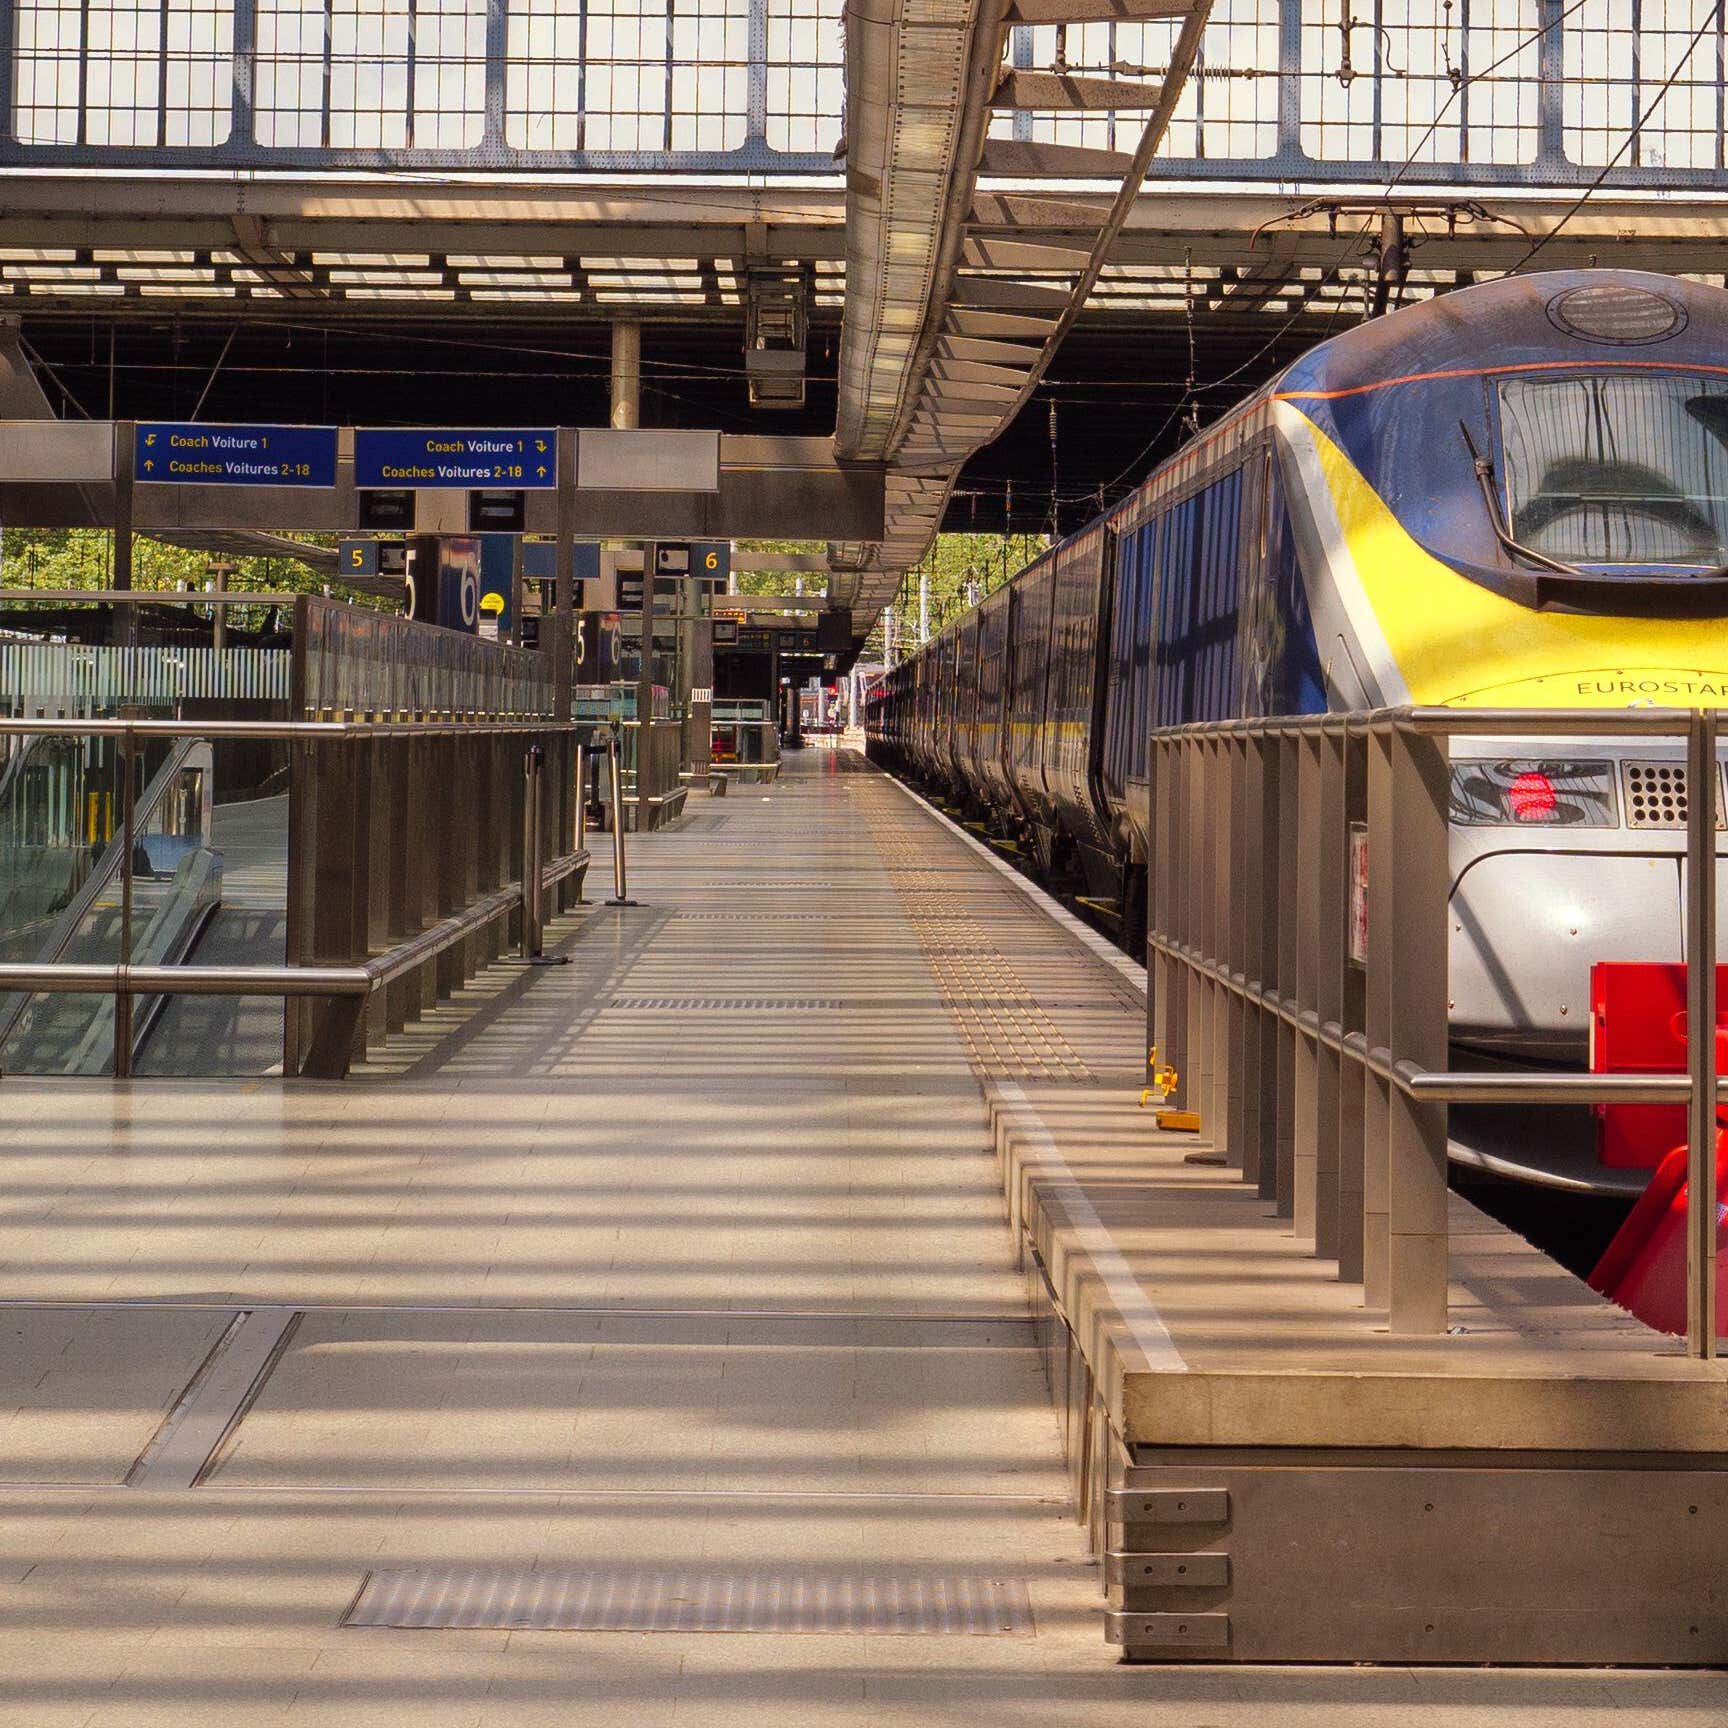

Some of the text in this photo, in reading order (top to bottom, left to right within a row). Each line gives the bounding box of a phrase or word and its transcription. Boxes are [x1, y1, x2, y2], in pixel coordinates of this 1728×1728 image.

[170, 434, 268, 449] Coach Voiture 1
[426, 440, 523, 453] Coach Voiture 1
[169, 460, 310, 476] Coaches Voitures 2-18
[381, 465, 523, 479] Coaches Voitures 2-18
[350, 549, 364, 568] 5
[705, 551, 719, 570] 6
[460, 552, 477, 626] 6
